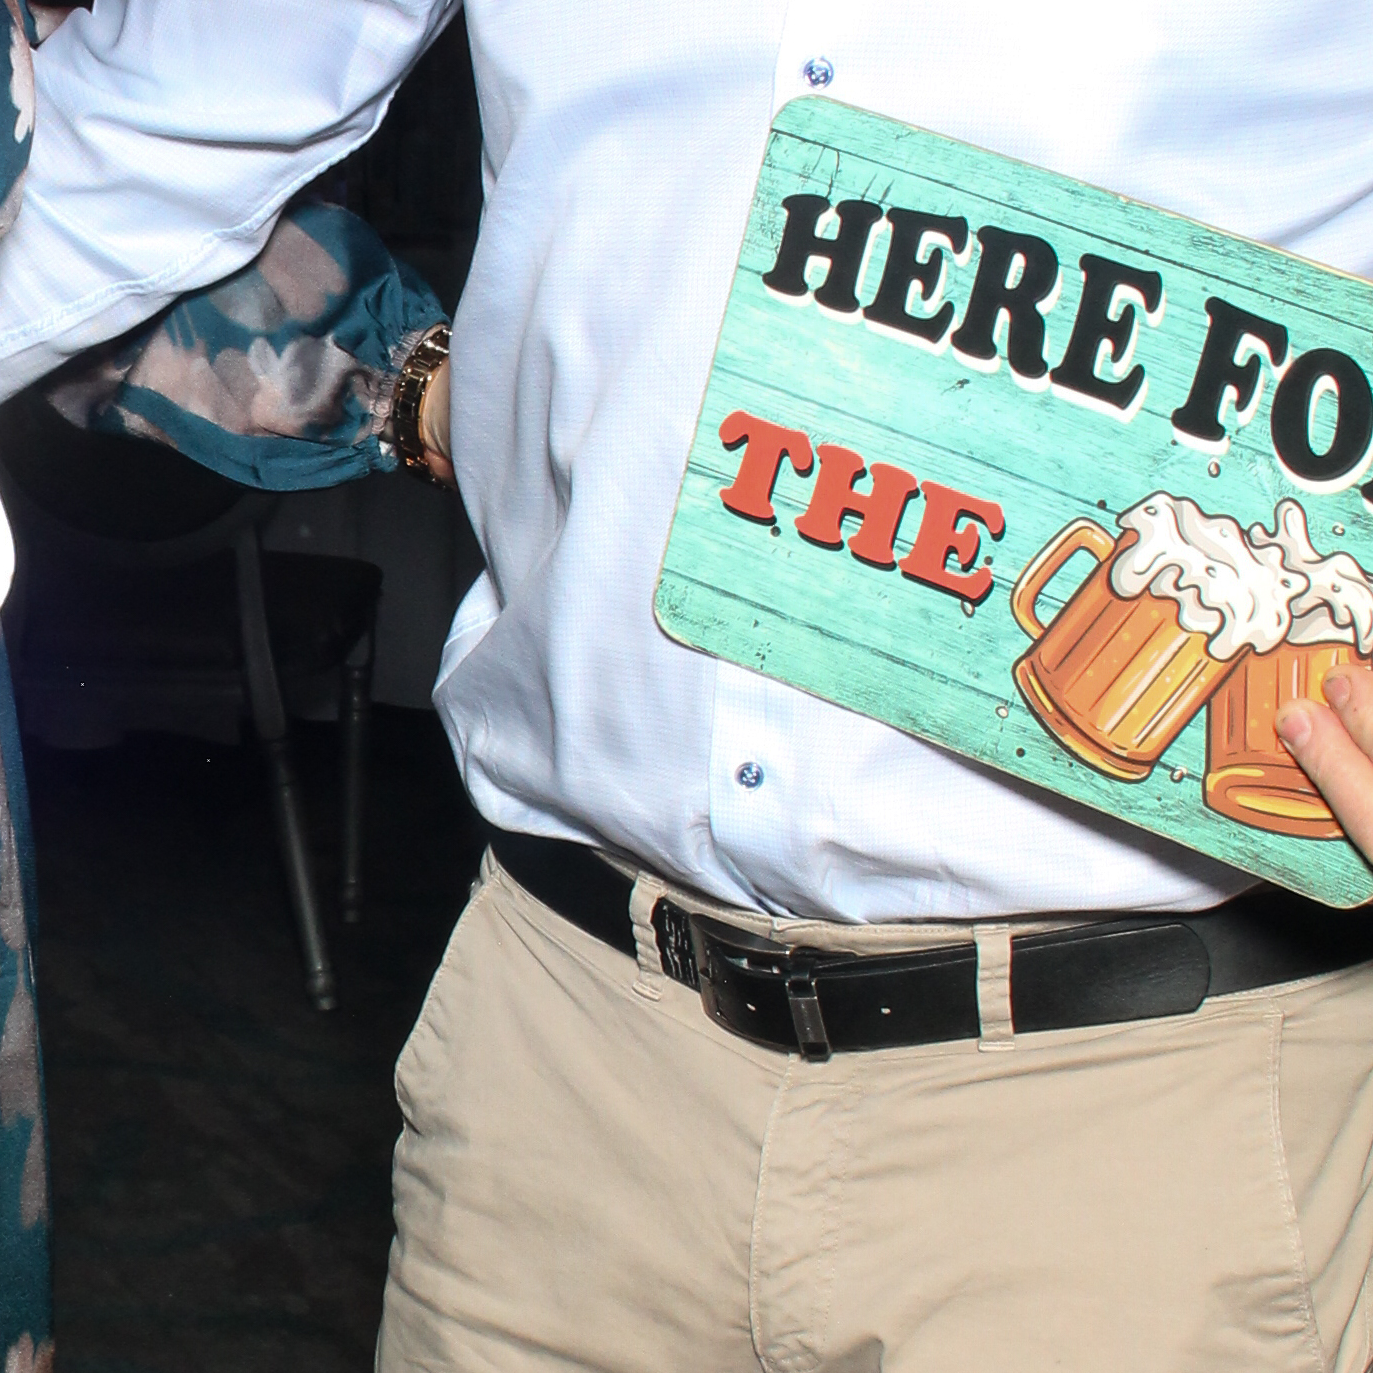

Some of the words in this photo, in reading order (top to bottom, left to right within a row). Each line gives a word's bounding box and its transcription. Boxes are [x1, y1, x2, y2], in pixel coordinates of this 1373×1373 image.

[762, 194, 1163, 415] HERE
[1171, 297, 1373, 505] FO
[719, 411, 1007, 605] THE
